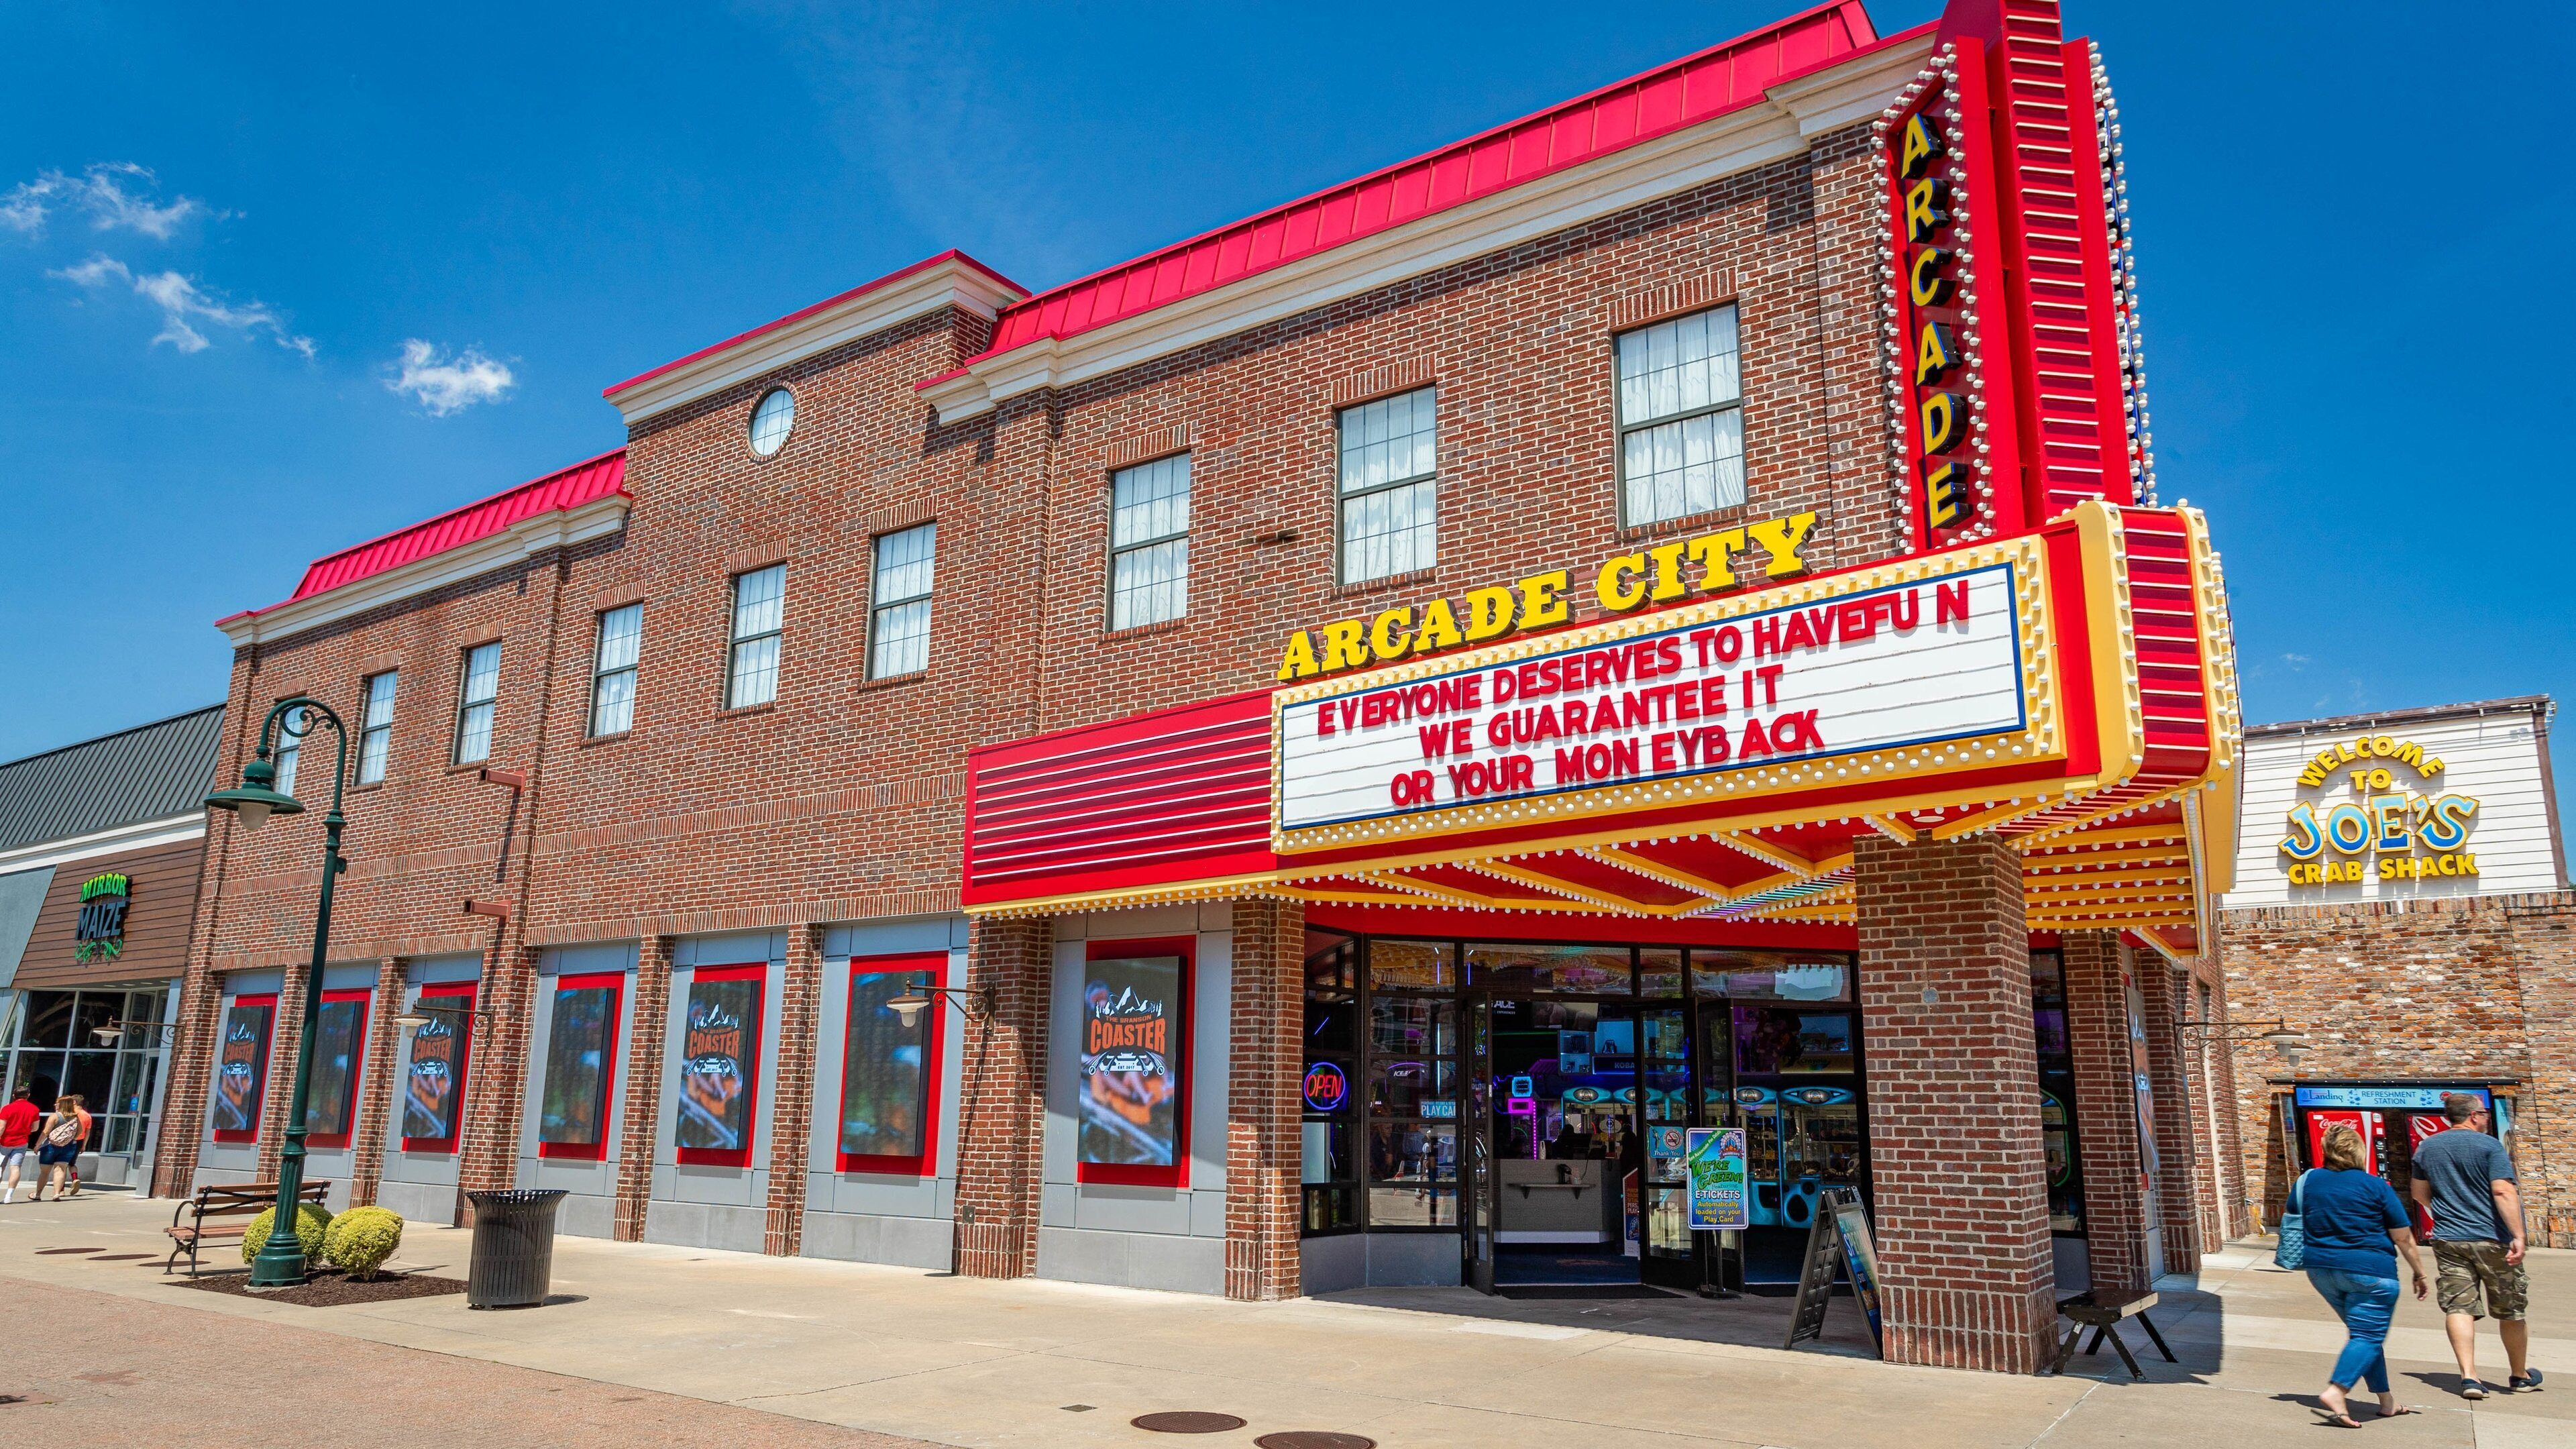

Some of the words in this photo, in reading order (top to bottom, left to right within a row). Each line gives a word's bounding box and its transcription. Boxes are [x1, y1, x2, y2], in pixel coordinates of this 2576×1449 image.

[1900, 112, 1964, 529] ARCADE
[1277, 569, 1572, 682] ARCADE
[1595, 511, 1819, 612] CITY
[1318, 673, 1482, 736] EVERYONE
[1493, 635, 1682, 704] DESERVES
[1690, 625, 1743, 668] TO
[1419, 718, 1473, 759] WE
[1487, 675, 1727, 747] GUARANTEE
[1743, 664, 1784, 709] IT
[2296, 735, 2446, 788] WELCOME
[1391, 769, 1434, 806] OR
[1448, 754, 1534, 798] YOUR
[2350, 767, 2392, 792] TO
[2278, 792, 2480, 860] JOE'S
[2288, 860, 2363, 885] CRAB
[2379, 853, 2479, 880] SHACK
[80, 873, 127, 903] MIRROR
[75, 900, 126, 941] MAIZE
[1120, 1014, 1152, 1023] BRANSON
[414, 1038, 451, 1063] COASTER
[689, 1029, 740, 1059] COASTER
[1090, 1018, 1166, 1055] COASTER
[1306, 1074, 1342, 1097] OPEN
[2309, 1089, 2344, 1103] Landing
[1421, 1105, 1441, 1116] PLAY
[1690, 1160, 1730, 1179] WE'RE
[1697, 1171, 1743, 1190] GREEN!
[1695, 1190, 1741, 1199] E-TICKETS
